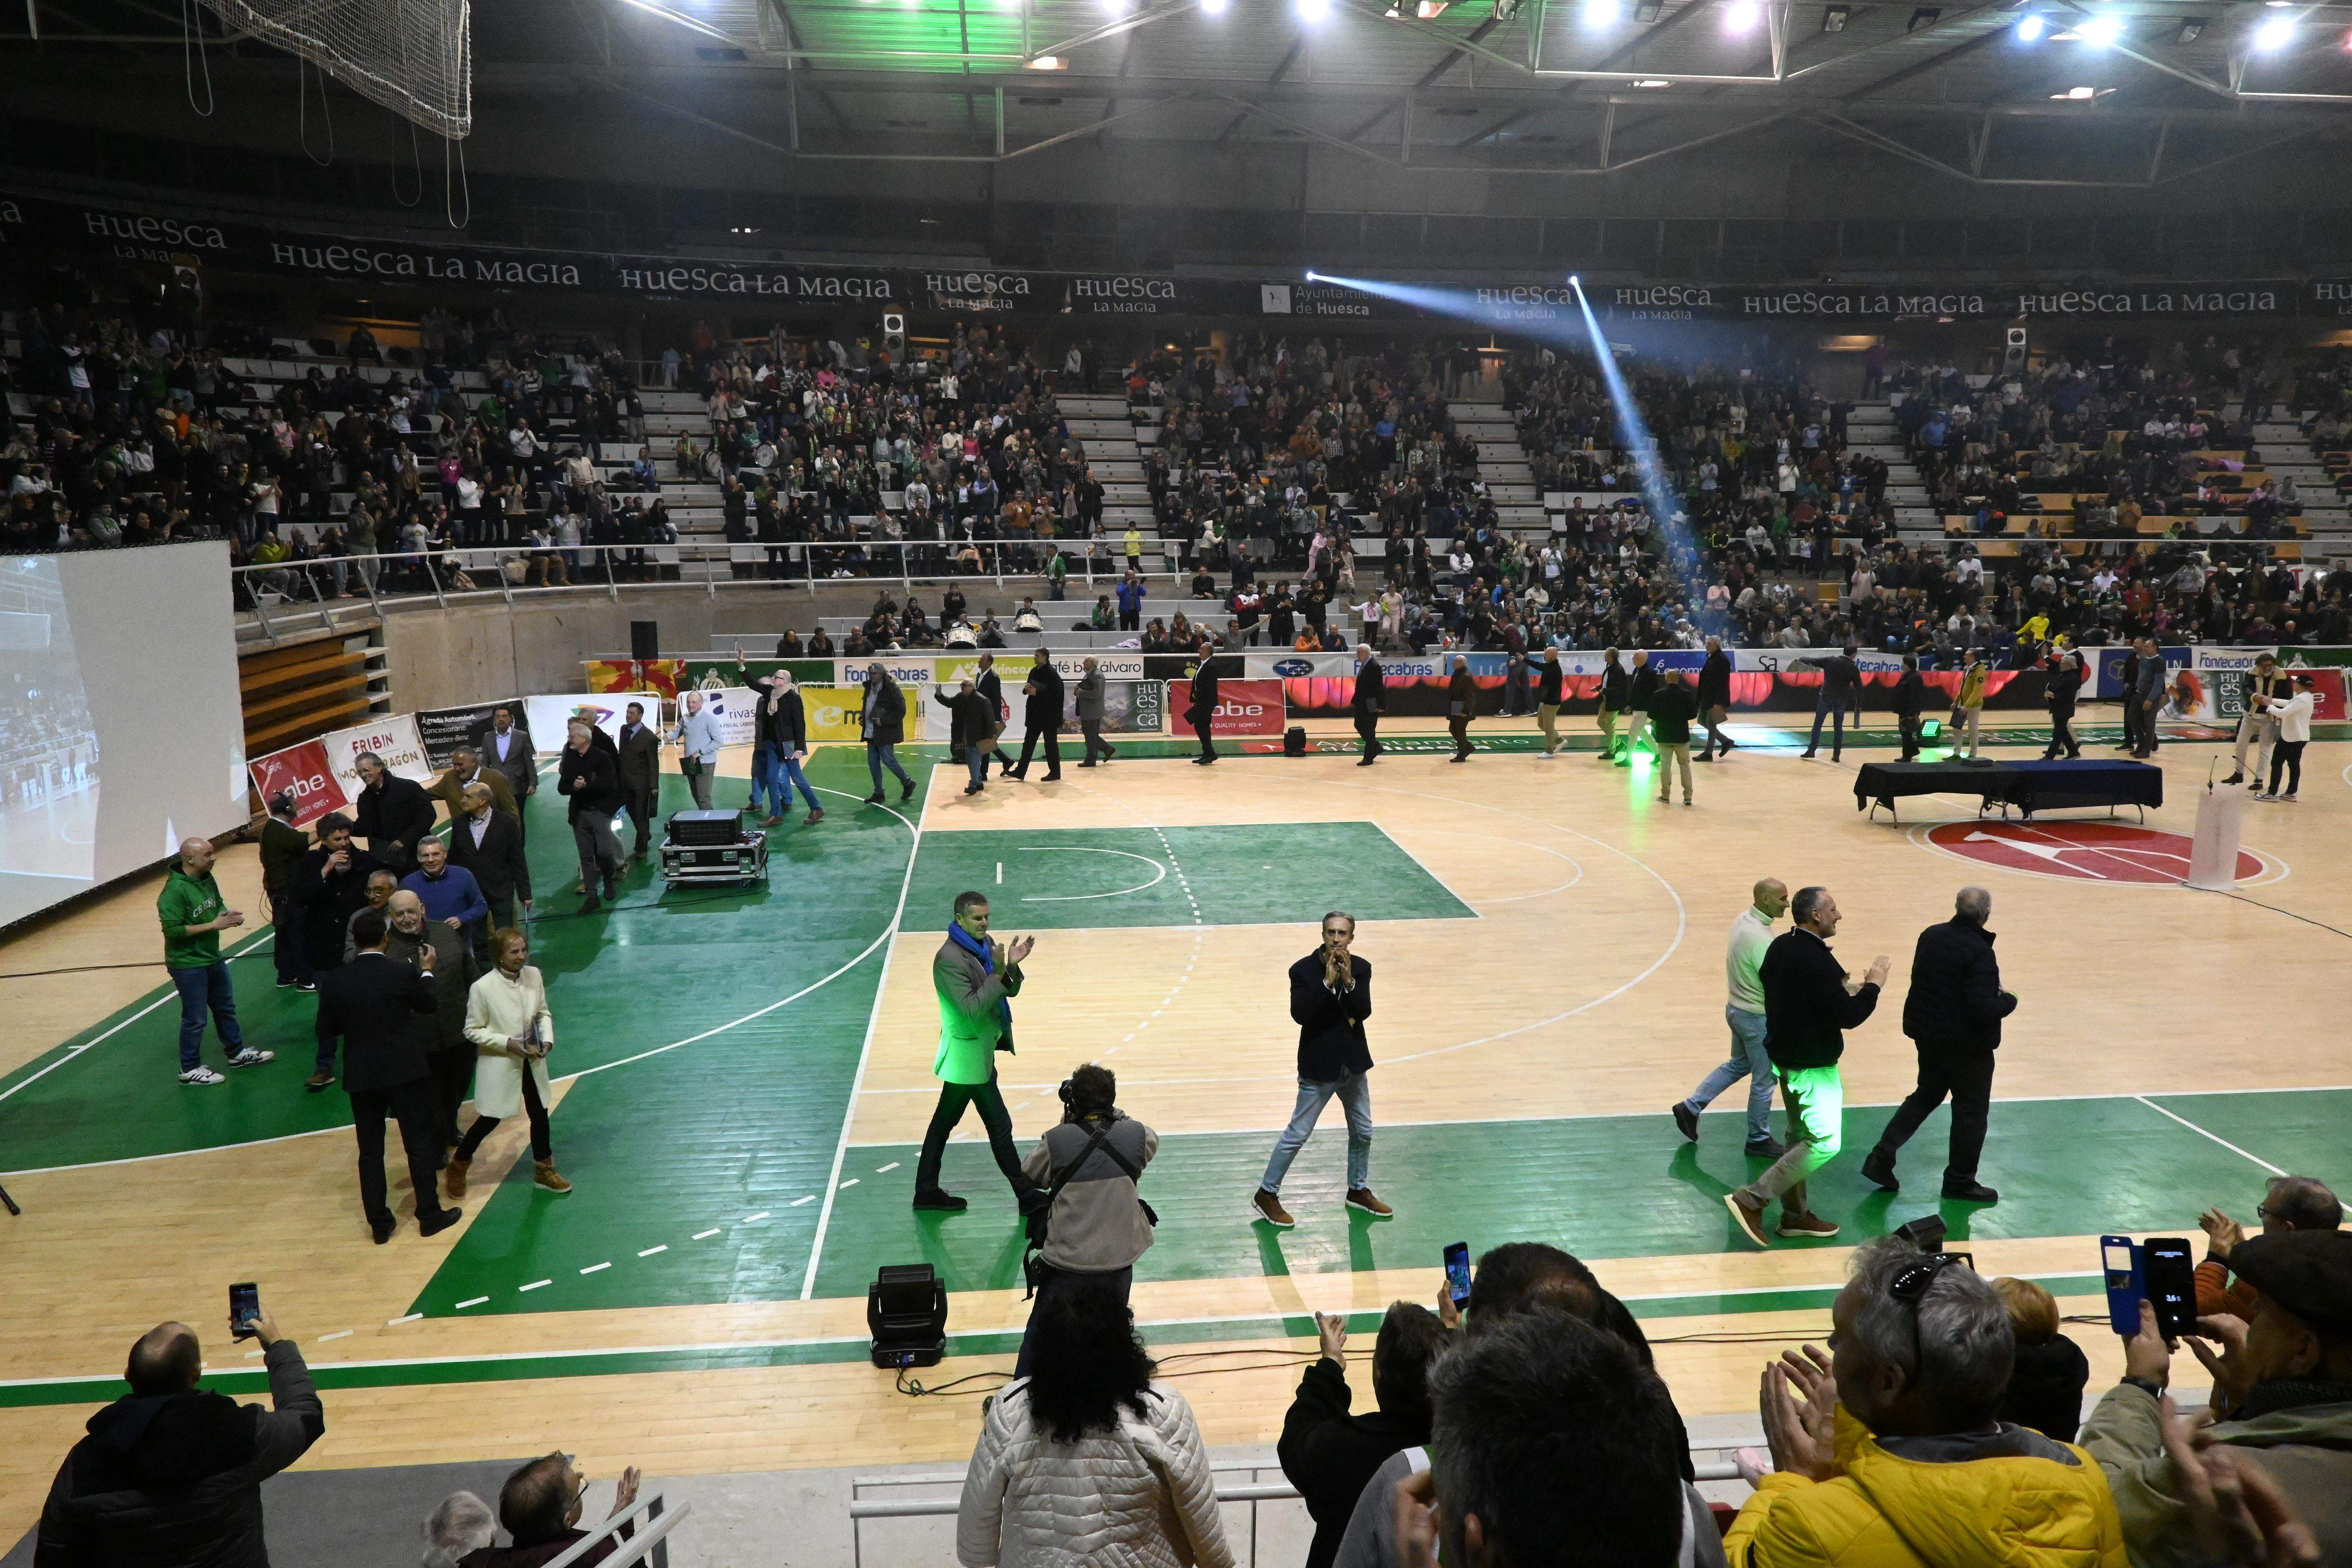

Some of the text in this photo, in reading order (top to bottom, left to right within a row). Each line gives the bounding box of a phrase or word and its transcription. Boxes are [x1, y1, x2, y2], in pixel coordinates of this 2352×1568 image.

[84, 213, 227, 248] Huesca
[270, 243, 417, 275] Huesca
[620, 267, 747, 292] Huesca
[925, 272, 1030, 294] Huesca
[1075, 276, 1176, 298] Huesca
[1476, 286, 1573, 305] Huesca
[1615, 286, 1712, 306] Huesca
[1743, 292, 1851, 314] Huesca
[2018, 291, 2132, 313] Huesca
[1296, 302, 1369, 315] de Huesca
[1100, 661, 1141, 672] álvaro
[729, 708, 756, 719] rivas
[1211, 700, 1263, 716] obe
[422, 725, 466, 735] Concesionario
[425, 735, 469, 745] Mercedes-Benz
[352, 732, 394, 755] FRIBIN
[274, 774, 325, 799] obe
